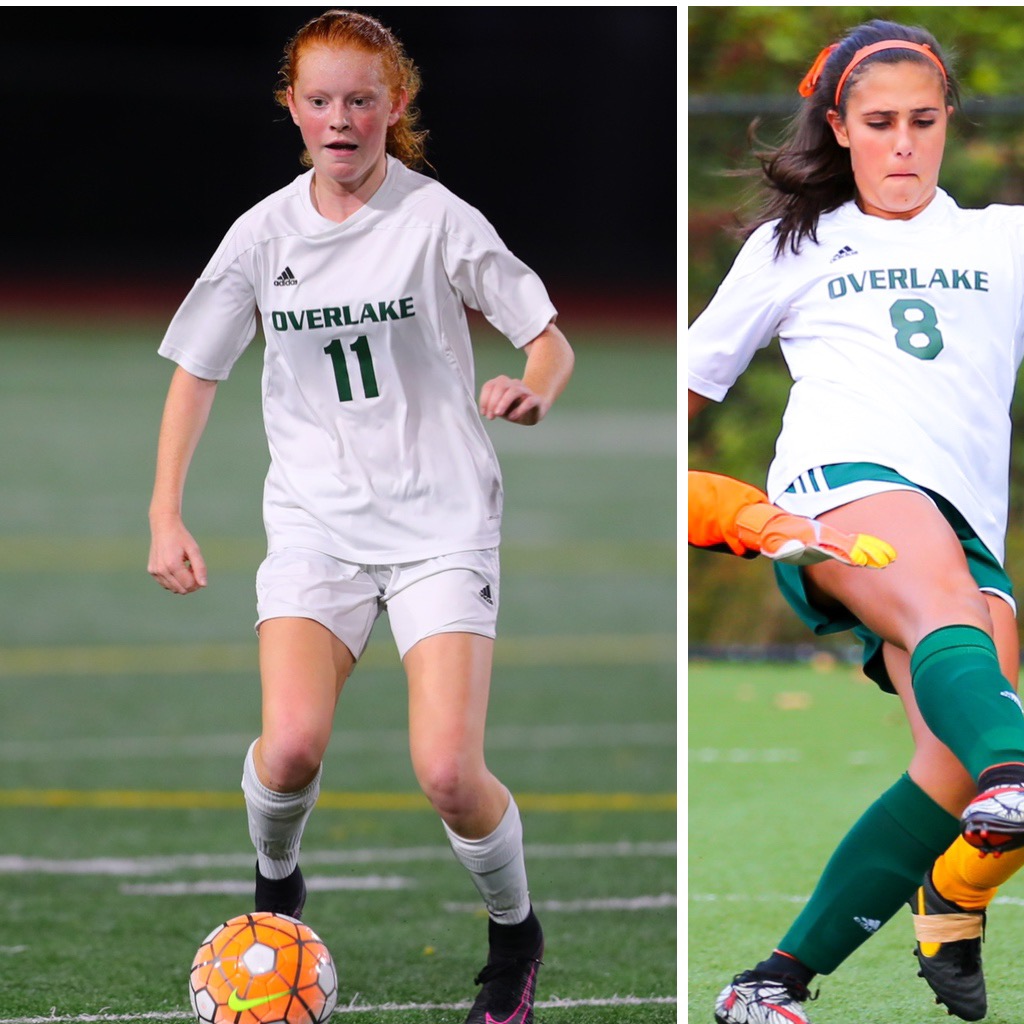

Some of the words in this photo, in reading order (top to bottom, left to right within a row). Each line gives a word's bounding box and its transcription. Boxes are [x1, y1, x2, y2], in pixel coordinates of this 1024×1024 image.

[827, 267, 989, 299] OVERLAKE
[272, 296, 416, 332] OVERLAKE
[889, 299, 944, 360] 8
[323, 335, 379, 402] 11
